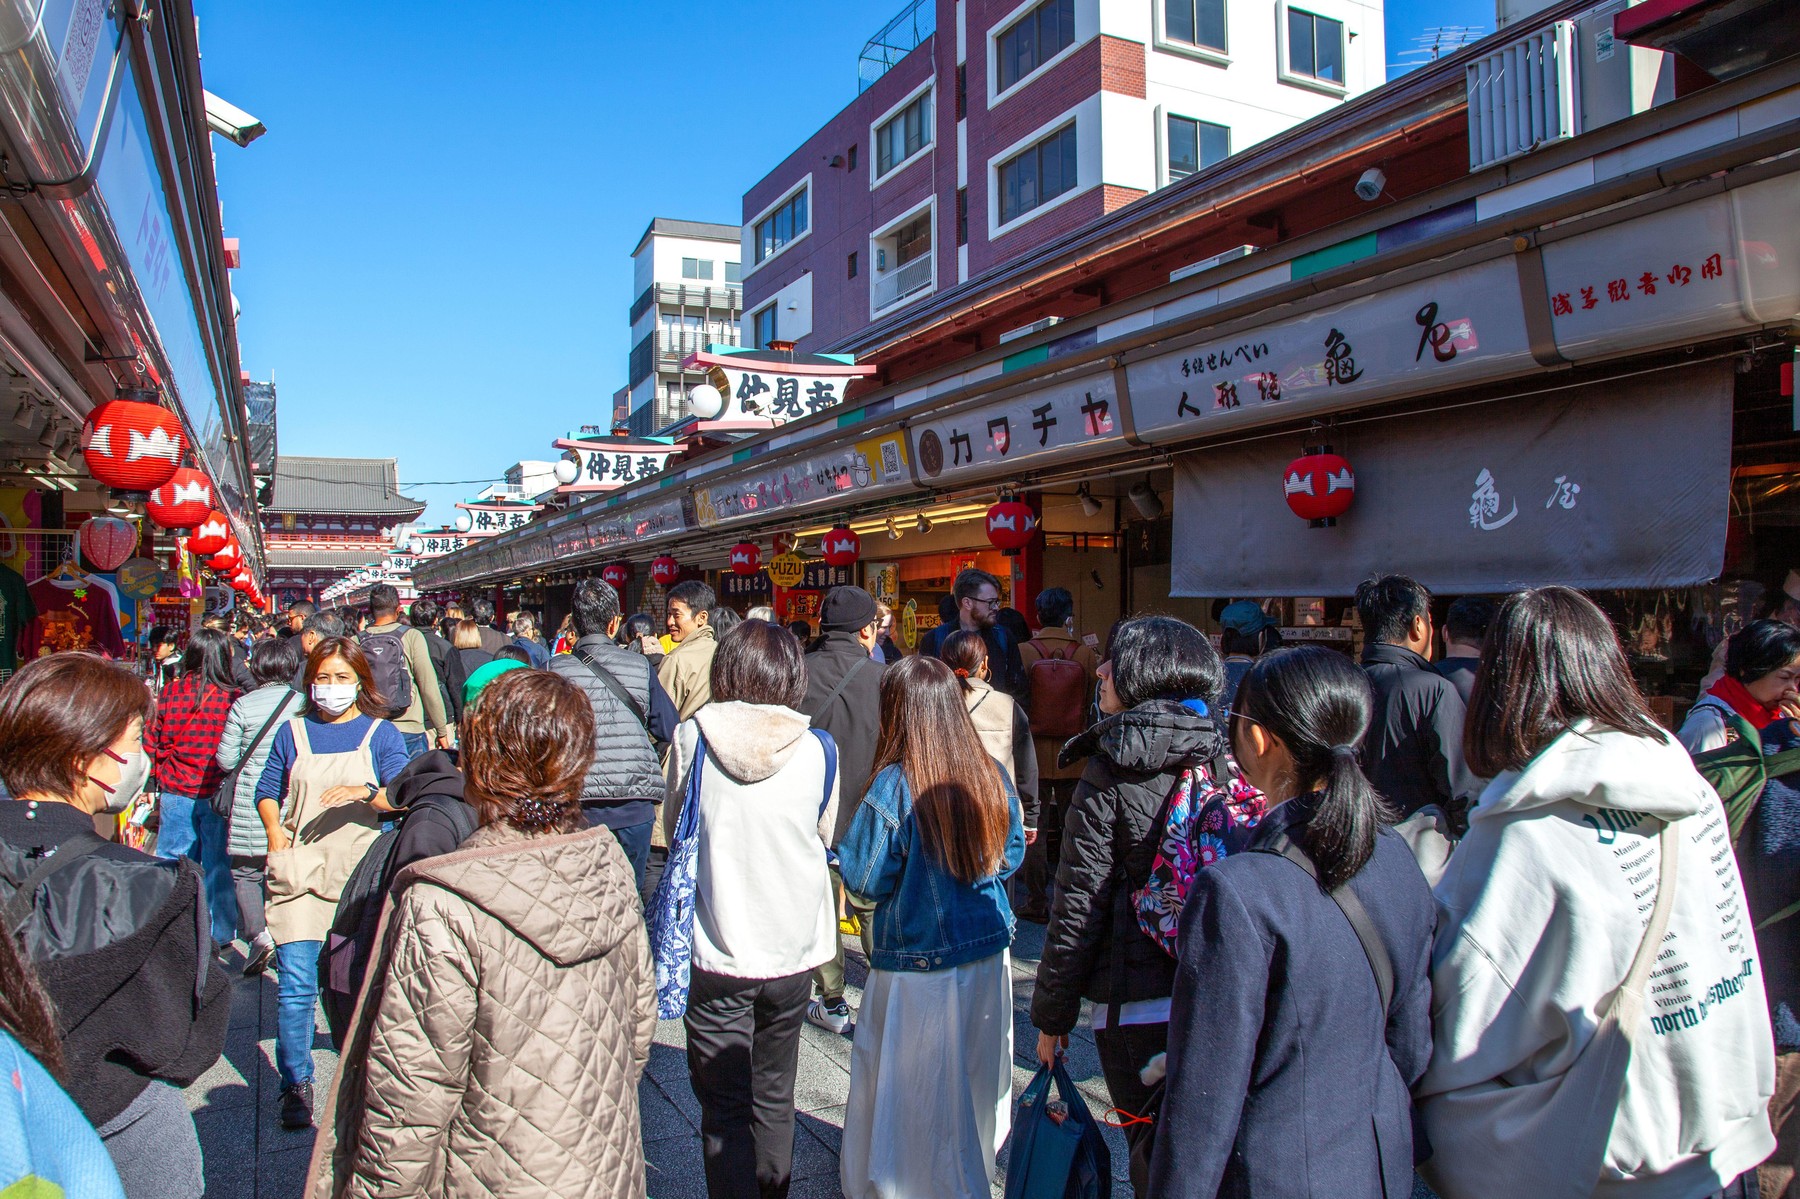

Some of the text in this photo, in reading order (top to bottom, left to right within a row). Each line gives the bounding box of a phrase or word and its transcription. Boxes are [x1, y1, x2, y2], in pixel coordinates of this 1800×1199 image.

[949, 392, 1109, 467] カワチヤ
[770, 562, 802, 575] YUZU
[1612, 840, 1641, 858] Manila
[1620, 848, 1656, 873] Singapore
[1626, 866, 1654, 886] Tallinn
[1651, 977, 1689, 995] Jakarta
[1654, 993, 1693, 1009] Vilnius
[1651, 1004, 1699, 1036] north
